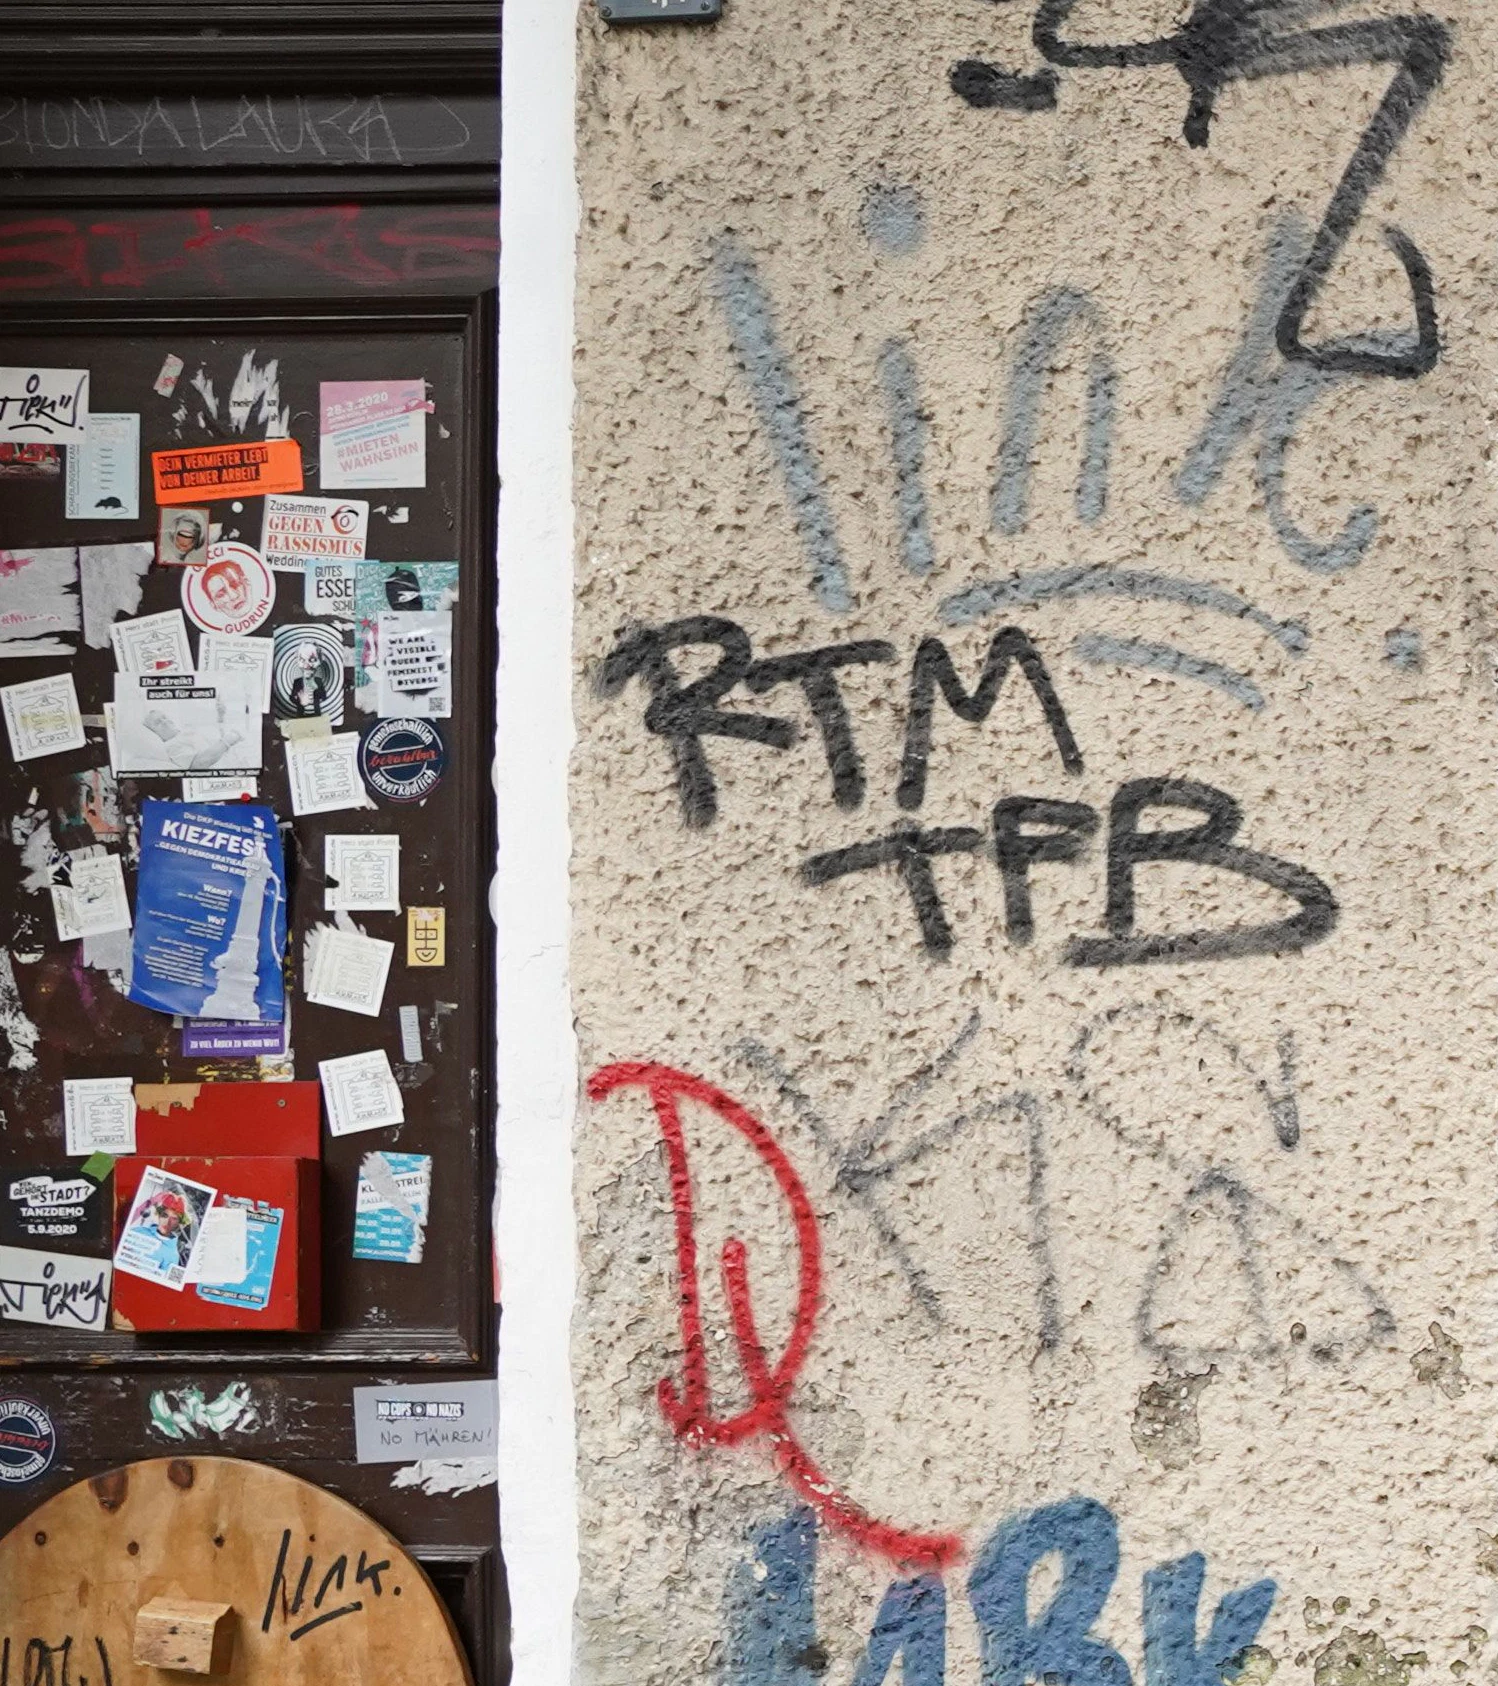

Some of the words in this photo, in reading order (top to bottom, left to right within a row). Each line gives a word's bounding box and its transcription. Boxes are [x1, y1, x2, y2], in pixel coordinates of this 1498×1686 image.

[339, 440, 419, 473] WAHNSINN
[269, 499, 327, 515] Zusammen
[267, 514, 326, 534] GEGEN
[266, 534, 363, 557] RASSISMUS
[224, 599, 270, 636] GUDRUN
[39, 1185, 91, 1203] STADT?
[20, 1206, 85, 1217] TANZDEMO
[28, 1224, 78, 1235] 5.9.2020
[378, 1402, 390, 1416] NO
[390, 1402, 412, 1417] COPS
[426, 1402, 438, 1417] NO
[438, 1402, 462, 1418] NAZIS
[380, 1431, 403, 1446] NO
